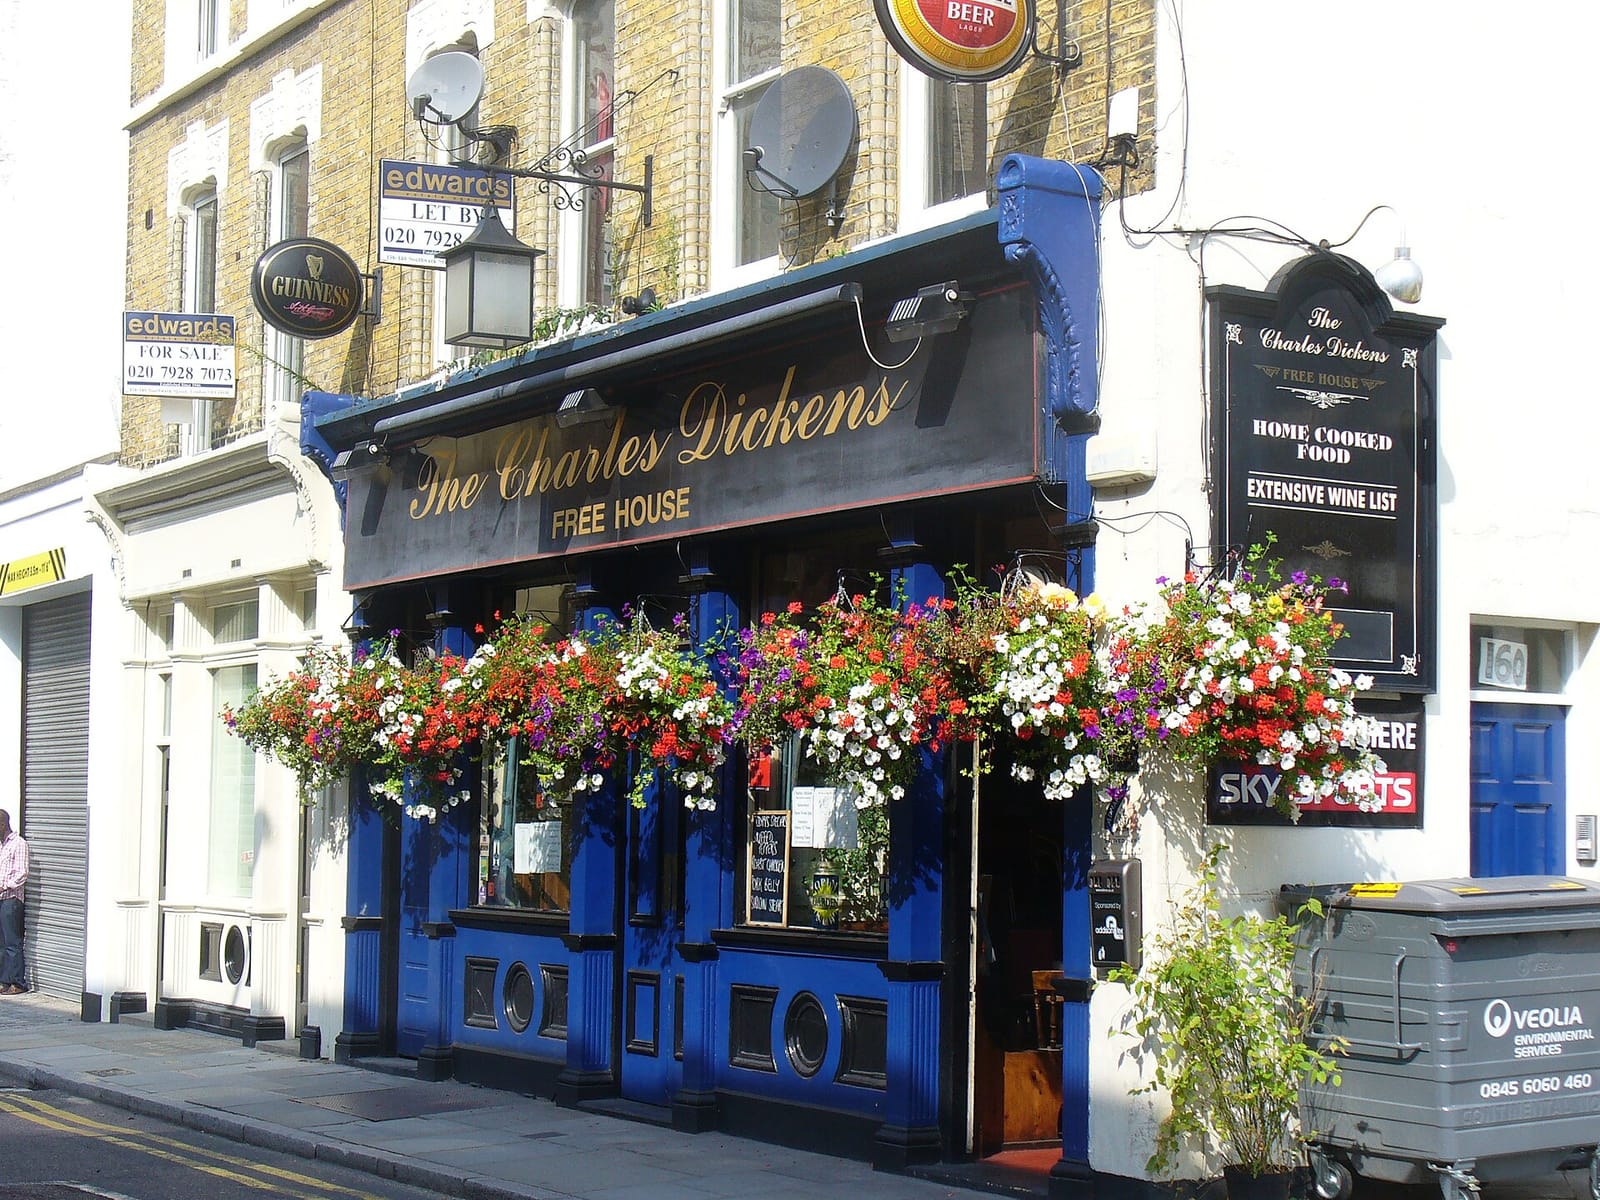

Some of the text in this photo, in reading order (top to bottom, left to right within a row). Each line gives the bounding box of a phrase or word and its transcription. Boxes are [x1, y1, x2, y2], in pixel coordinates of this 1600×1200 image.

[947, 2, 995, 27] BEER
[959, 24, 983, 33] LAGER
[386, 166, 509, 198] edwards
[412, 203, 484, 224] LET BY
[385, 226, 463, 248] 020 7928
[271, 275, 350, 307] GUINNESS
[128, 314, 232, 337] edwards
[1307, 307, 1342, 330] The
[140, 345, 223, 361] FOR SALE
[1259, 327, 1390, 363] Charles Dickens
[128, 365, 232, 381] 020 7928 7073
[1283, 368, 1361, 389] FREE HOUSE
[409, 364, 909, 520] The Charles Dickens
[1253, 419, 1393, 451] HOME COOKED
[1296, 443, 1351, 464] FOOD
[1247, 478, 1397, 512] EXTENSIVE WINE LIST
[552, 486, 690, 540] FREE HOUSE
[1485, 641, 1525, 688] 160
[1219, 773, 1283, 808] SKY
[1513, 1006, 1583, 1030] VEOLIA
[1514, 1028, 1595, 1046] ENVIRONMENTAL
[1514, 1043, 1562, 1058] SERVICES
[1480, 1073, 1592, 1098] 0845 6060 460
